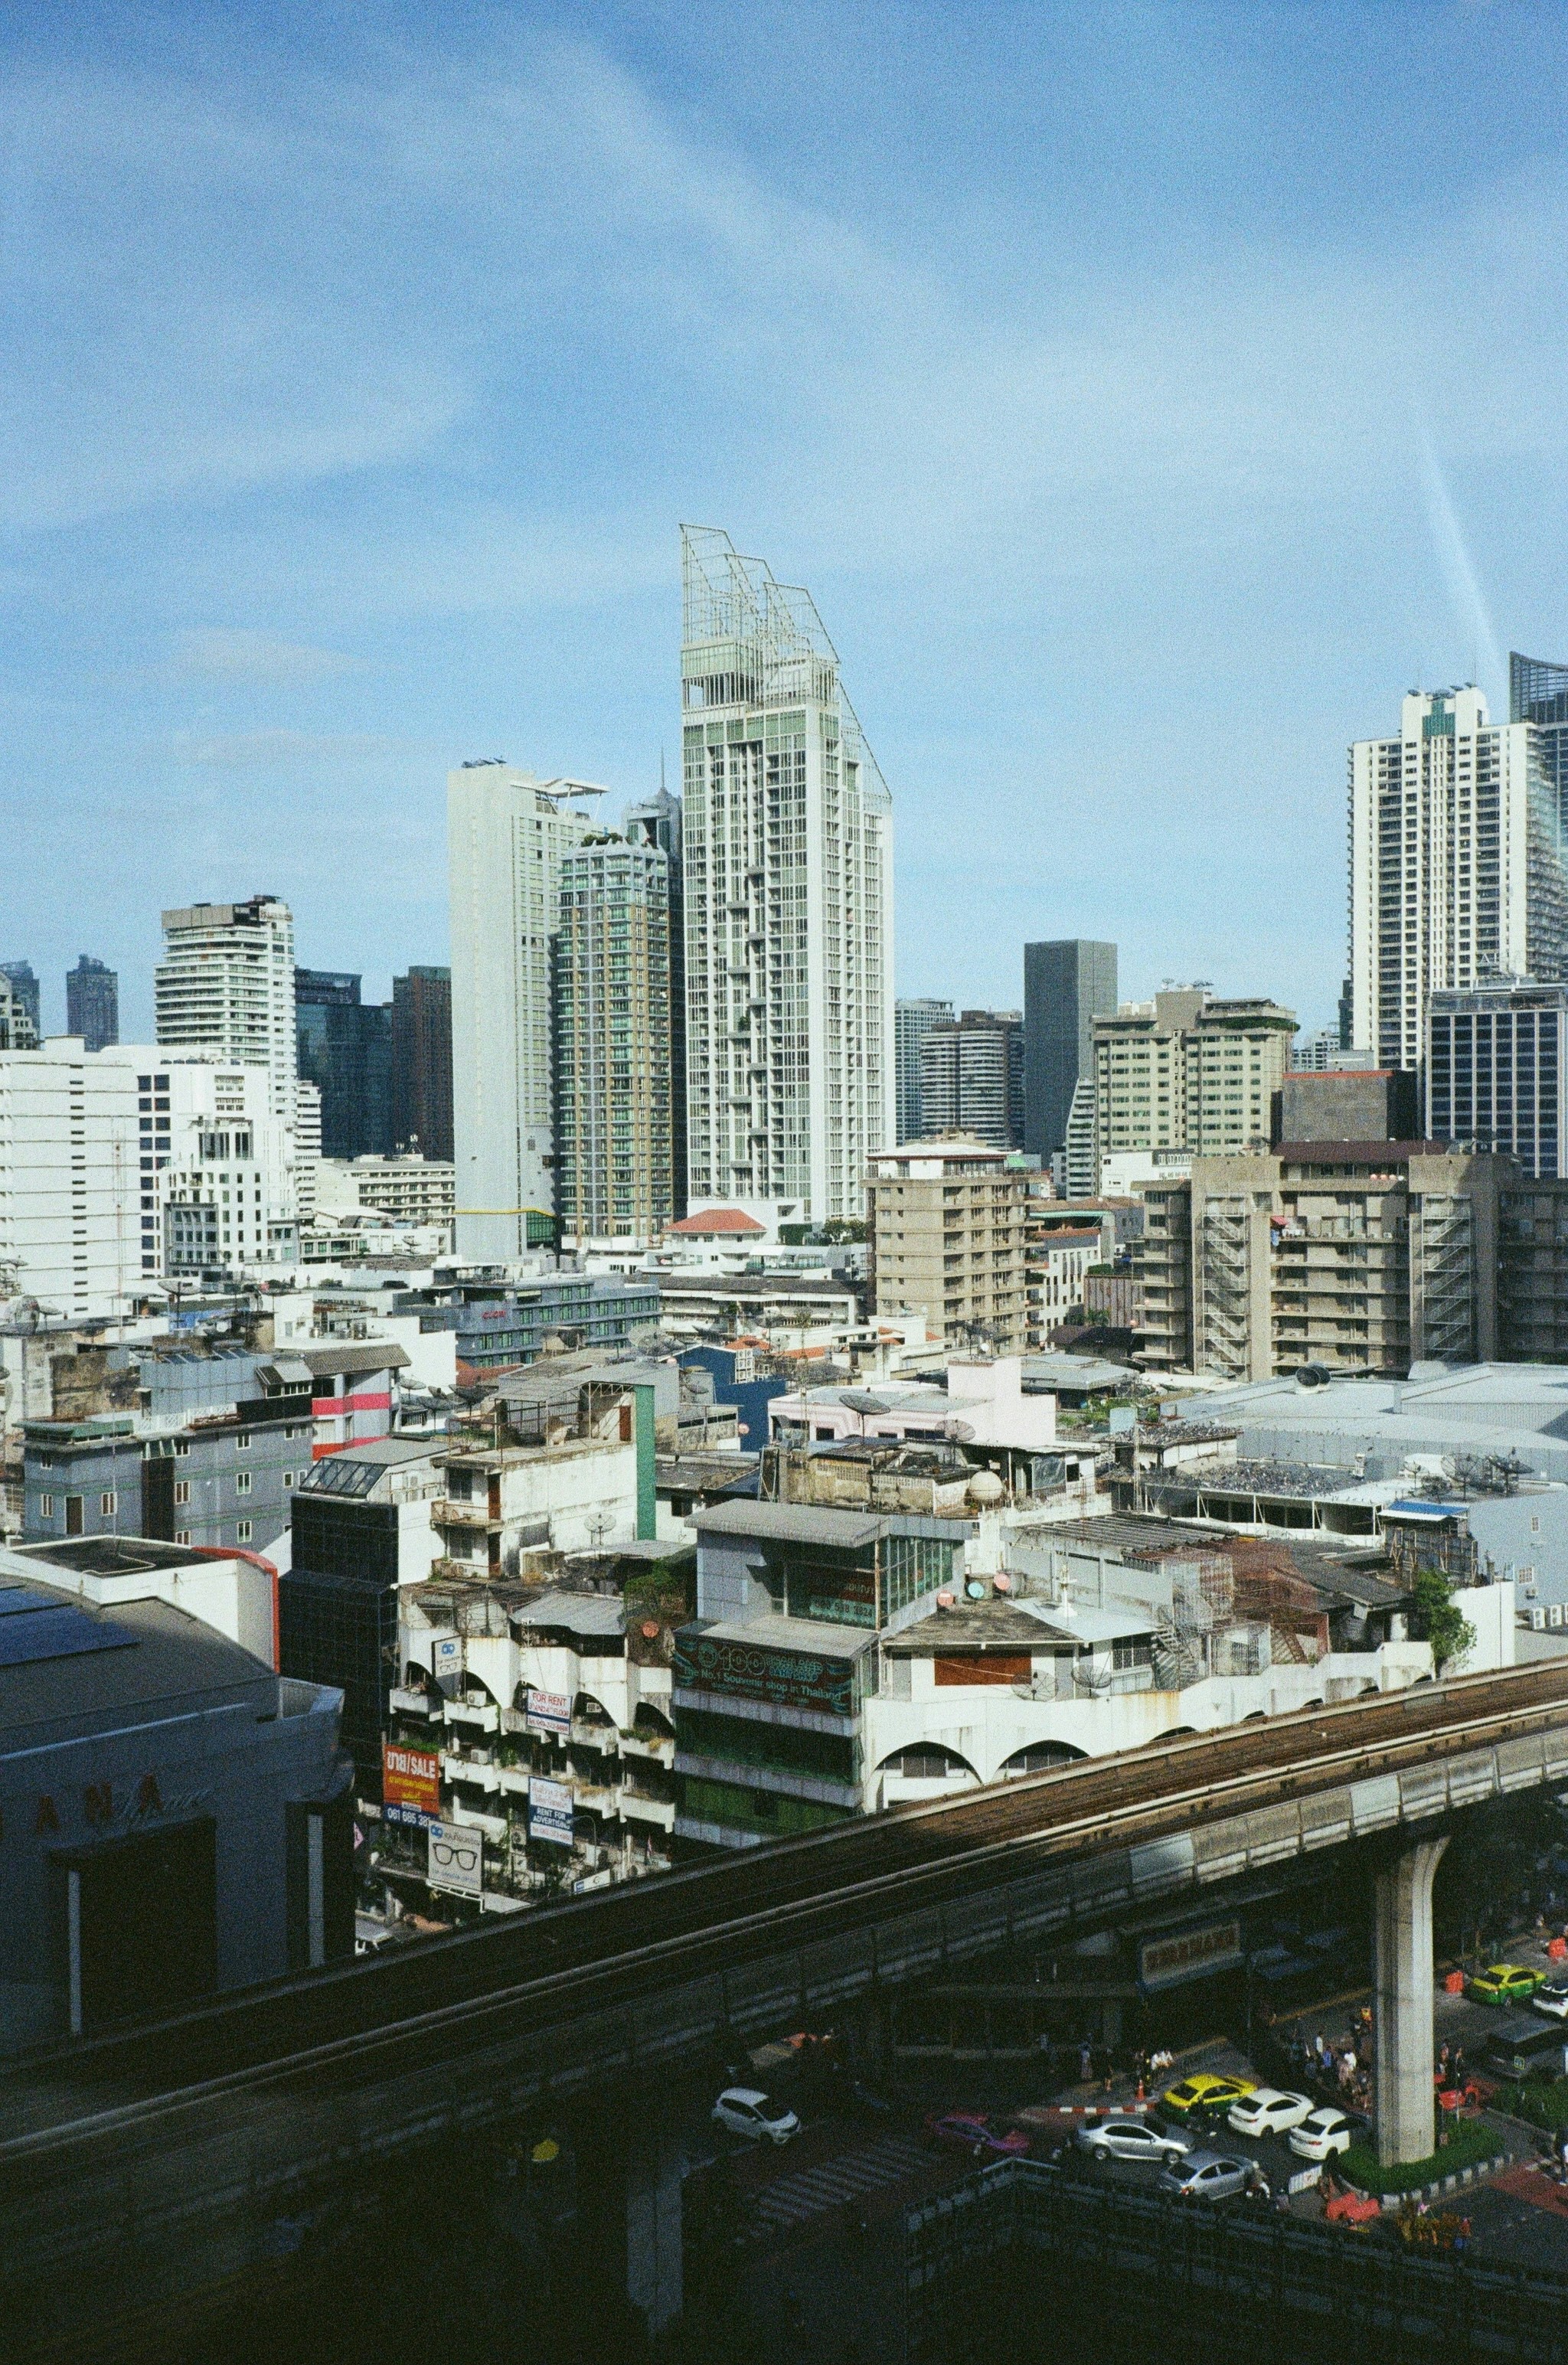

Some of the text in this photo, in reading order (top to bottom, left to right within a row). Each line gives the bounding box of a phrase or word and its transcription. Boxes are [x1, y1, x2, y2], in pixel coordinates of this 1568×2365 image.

[532, 1692, 567, 1707] FOR RENT
[537, 1806, 566, 1821] RENT FOR
